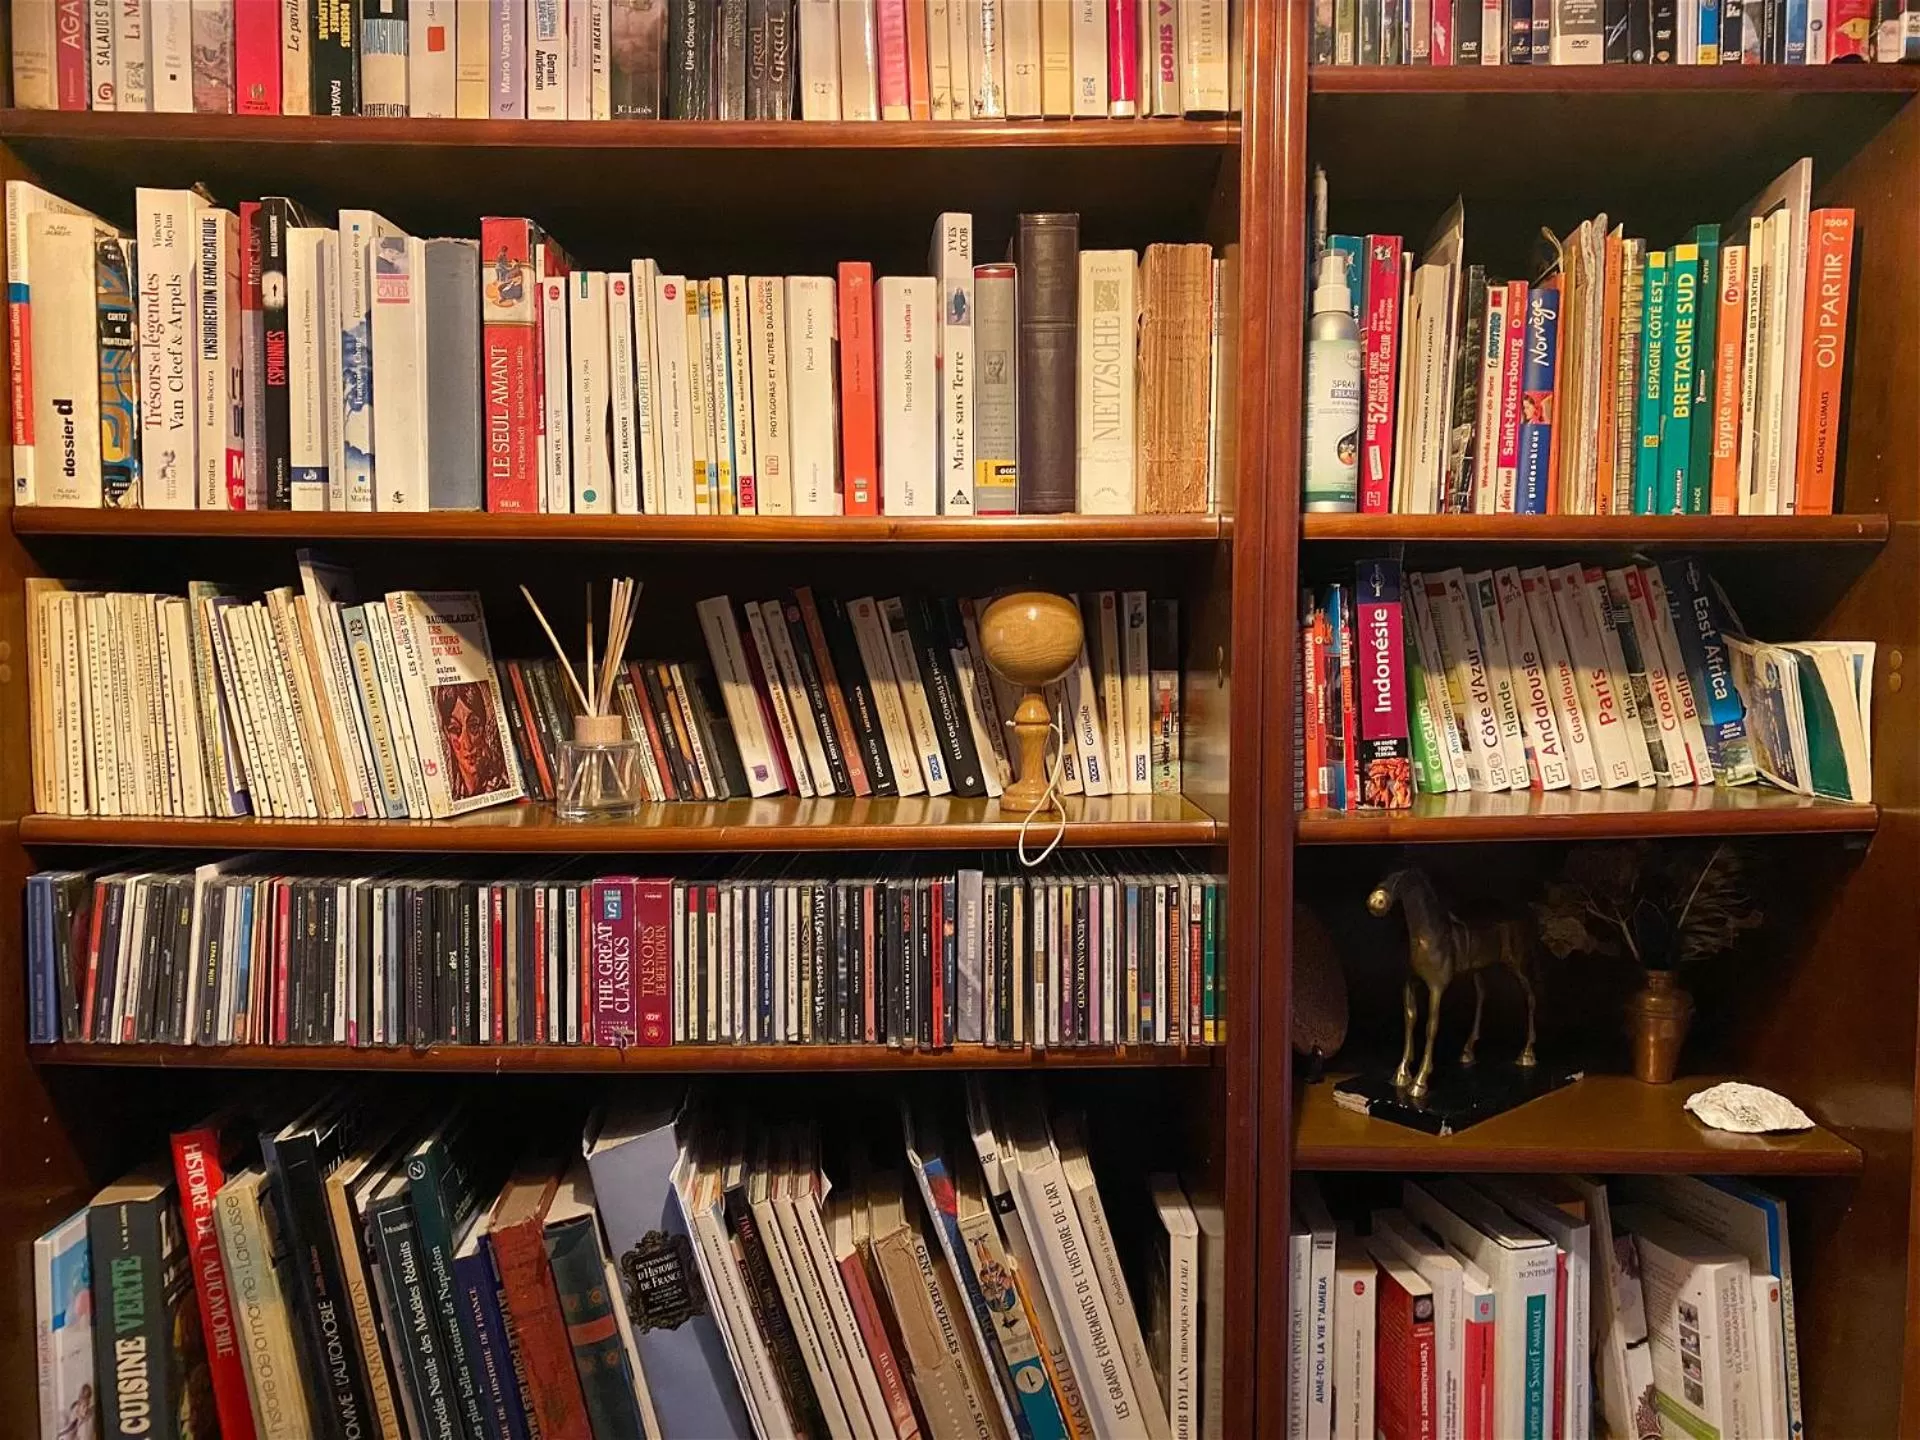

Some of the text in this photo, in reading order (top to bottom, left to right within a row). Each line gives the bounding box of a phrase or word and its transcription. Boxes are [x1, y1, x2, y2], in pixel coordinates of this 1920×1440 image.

[95, 9, 111, 66] SALAUDS
[499, 23, 513, 94] Mario Vargas
[685, 25, 696, 54] douce
[1159, 24, 1174, 83] BORIS
[535, 49, 545, 91] Anderson
[547, 53, 557, 86] Geraint
[152, 212, 163, 248] Vincent
[163, 213, 175, 248] Meylan
[947, 226, 958, 252] YVES
[958, 226, 969, 260] JACOB
[202, 217, 218, 361] L'INSURRECTION DEMOCRATIQUE
[247, 253, 261, 285] Marc
[1749, 266, 1759, 330] BRUXELLES
[167, 273, 189, 329] Arpels
[1815, 232, 1844, 369] OÙ PARTIR ?
[143, 273, 165, 431] Trésors et légendes
[266, 330, 285, 386] ESPIONNES
[764, 279, 778, 438] PROTAGORAS ET AUTRES DIALOGUES
[1527, 297, 1557, 367] Norvège
[1647, 279, 1664, 399] ESPAGNE CÔTÉ EST
[1672, 272, 1695, 419] BRETAGNE SUD
[167, 349, 184, 393] Cleef
[516, 372, 526, 419] Jean-Claude
[903, 349, 913, 413] Thomas Hobbes
[1091, 315, 1121, 442] NIETZSCHE
[1366, 351, 1389, 441] NOS 52 WEEK-ENDS
[1378, 363, 1390, 403] COUPS DE
[1501, 337, 1523, 457] Saint-Pétersbourg
[52, 398, 76, 478] dossier d
[168, 399, 185, 431] Van
[490, 344, 511, 478] LE SEUL AMANT
[640, 419, 650, 435] LE
[951, 350, 965, 471] Marie sans Terre
[1481, 441, 1490, 489] Week-ends
[1486, 375, 1495, 398] Paris
[1815, 390, 1830, 475] SAISONS CLIMATS
[207, 458, 217, 505] Democratica
[739, 476, 752, 508] 10 18
[395, 593, 418, 677] LES FLEURS DU MAL
[428, 625, 442, 635] LES
[430, 635, 460, 646] FLEURS
[432, 645, 463, 656] DU MAL
[1371, 607, 1392, 713] Indonésie
[1693, 596, 1728, 701] East Africa
[1305, 631, 1315, 694] AMSTERDAM
[937, 684, 953, 720] CONQUIS
[1464, 647, 1503, 749] Côte d'Azur
[1498, 680, 1517, 738] Islande
[1521, 650, 1558, 757] Andalousie
[1559, 660, 1584, 744] Guadeloupe
[1590, 667, 1617, 727] Paris
[1621, 682, 1637, 719] Malte
[1652, 669, 1677, 732] Croatie
[1675, 670, 1696, 719] Berlin
[953, 738, 963, 760] ELLES
[1441, 699, 1461, 755] Amsterdam
[606, 902, 618, 918] 5
[597, 921, 614, 1013] THE GREAT
[614, 936, 630, 1014] CLASSICS
[642, 925, 656, 997] TRESORS
[655, 924, 667, 995] DE BEETHOVEN
[183, 1142, 216, 1240] HISTOIRE DE
[737, 1214, 753, 1243] TIME
[431, 1244, 453, 1303] Napoléon
[640, 1270, 683, 1292] DE FRANCE
[914, 1244, 961, 1356] CENT MERVEILLES
[1043, 1180, 1131, 1422] LES GRANDS DE L'HISTOIRE DE L'ART
[349, 1279, 387, 1377] NAVIGATION
[398, 1240, 445, 1398] Navale des Modèles Réduits
[441, 1301, 454, 1317] de
[445, 1314, 466, 1364] victoires
[1178, 1303, 1190, 1364] CHRONIQUES
[1316, 1275, 1329, 1354] LA VIE T'AIMERA
[110, 1254, 151, 1436] CUISINE VERTE
[455, 1362, 475, 1402] belles
[1049, 1349, 1093, 1436] MAGRITTE
[1177, 1367, 1190, 1417] DYLAN
